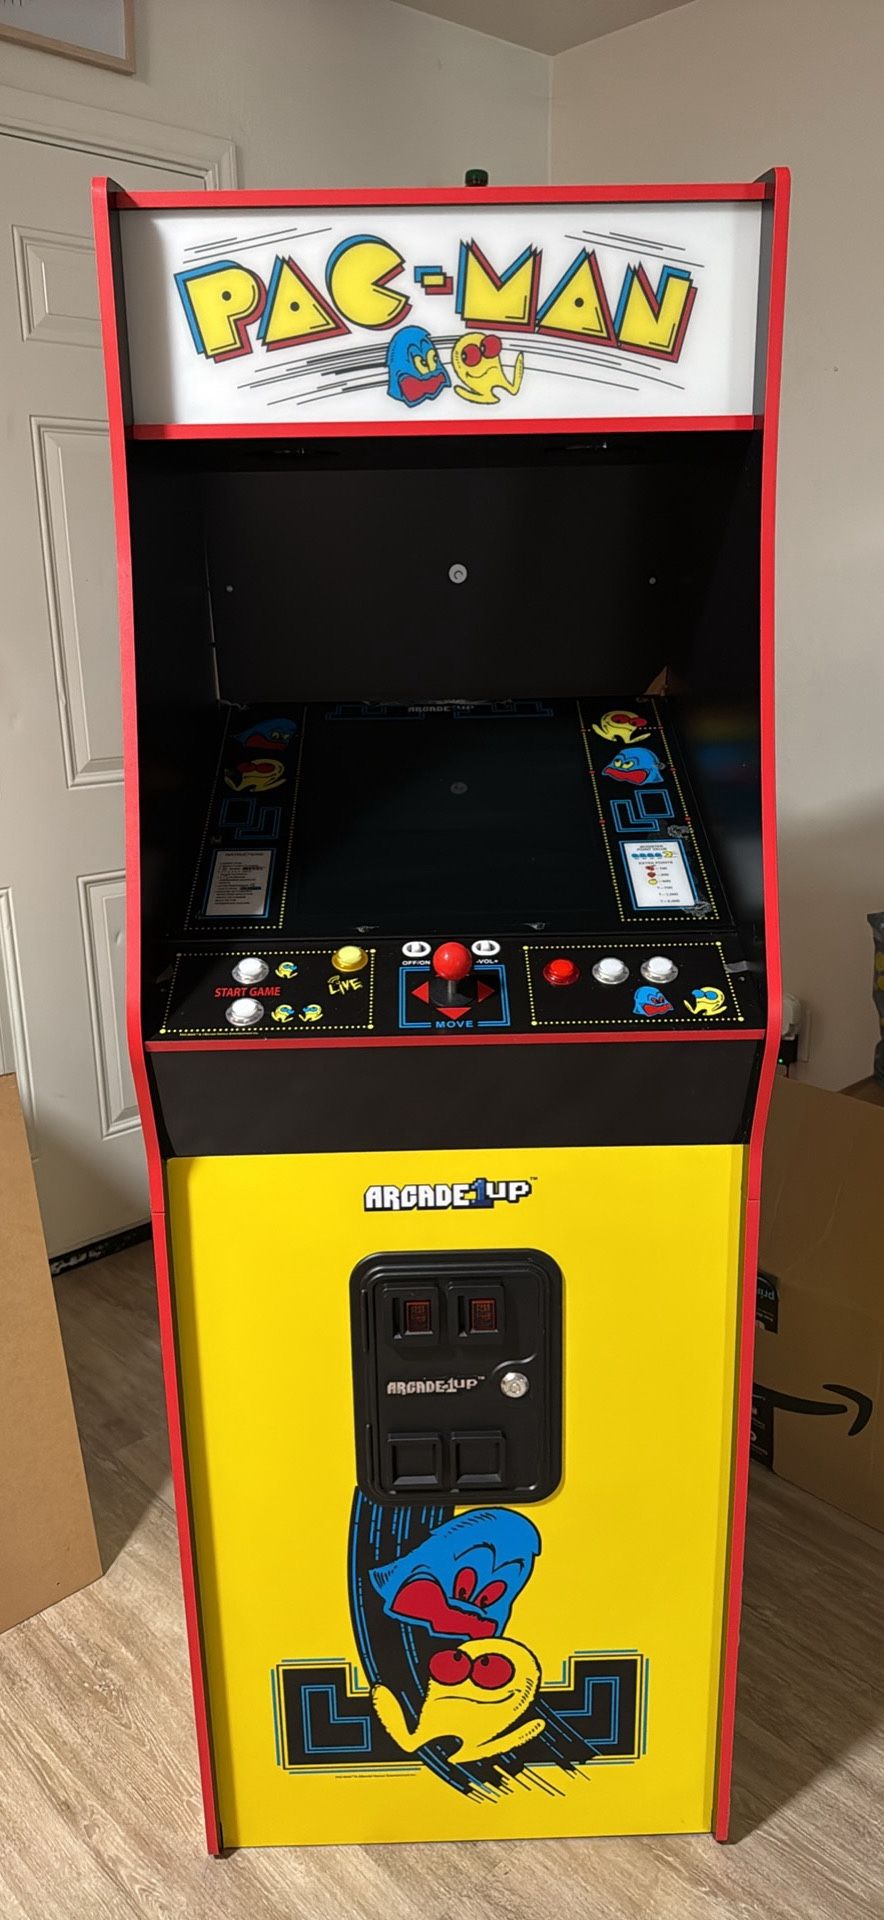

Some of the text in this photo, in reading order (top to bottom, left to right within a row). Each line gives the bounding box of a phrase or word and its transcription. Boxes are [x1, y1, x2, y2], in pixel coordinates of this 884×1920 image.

[173, 233, 697, 364] PAC-MAN
[214, 986, 281, 998] START GAME
[435, 1020, 474, 1029] MOVE
